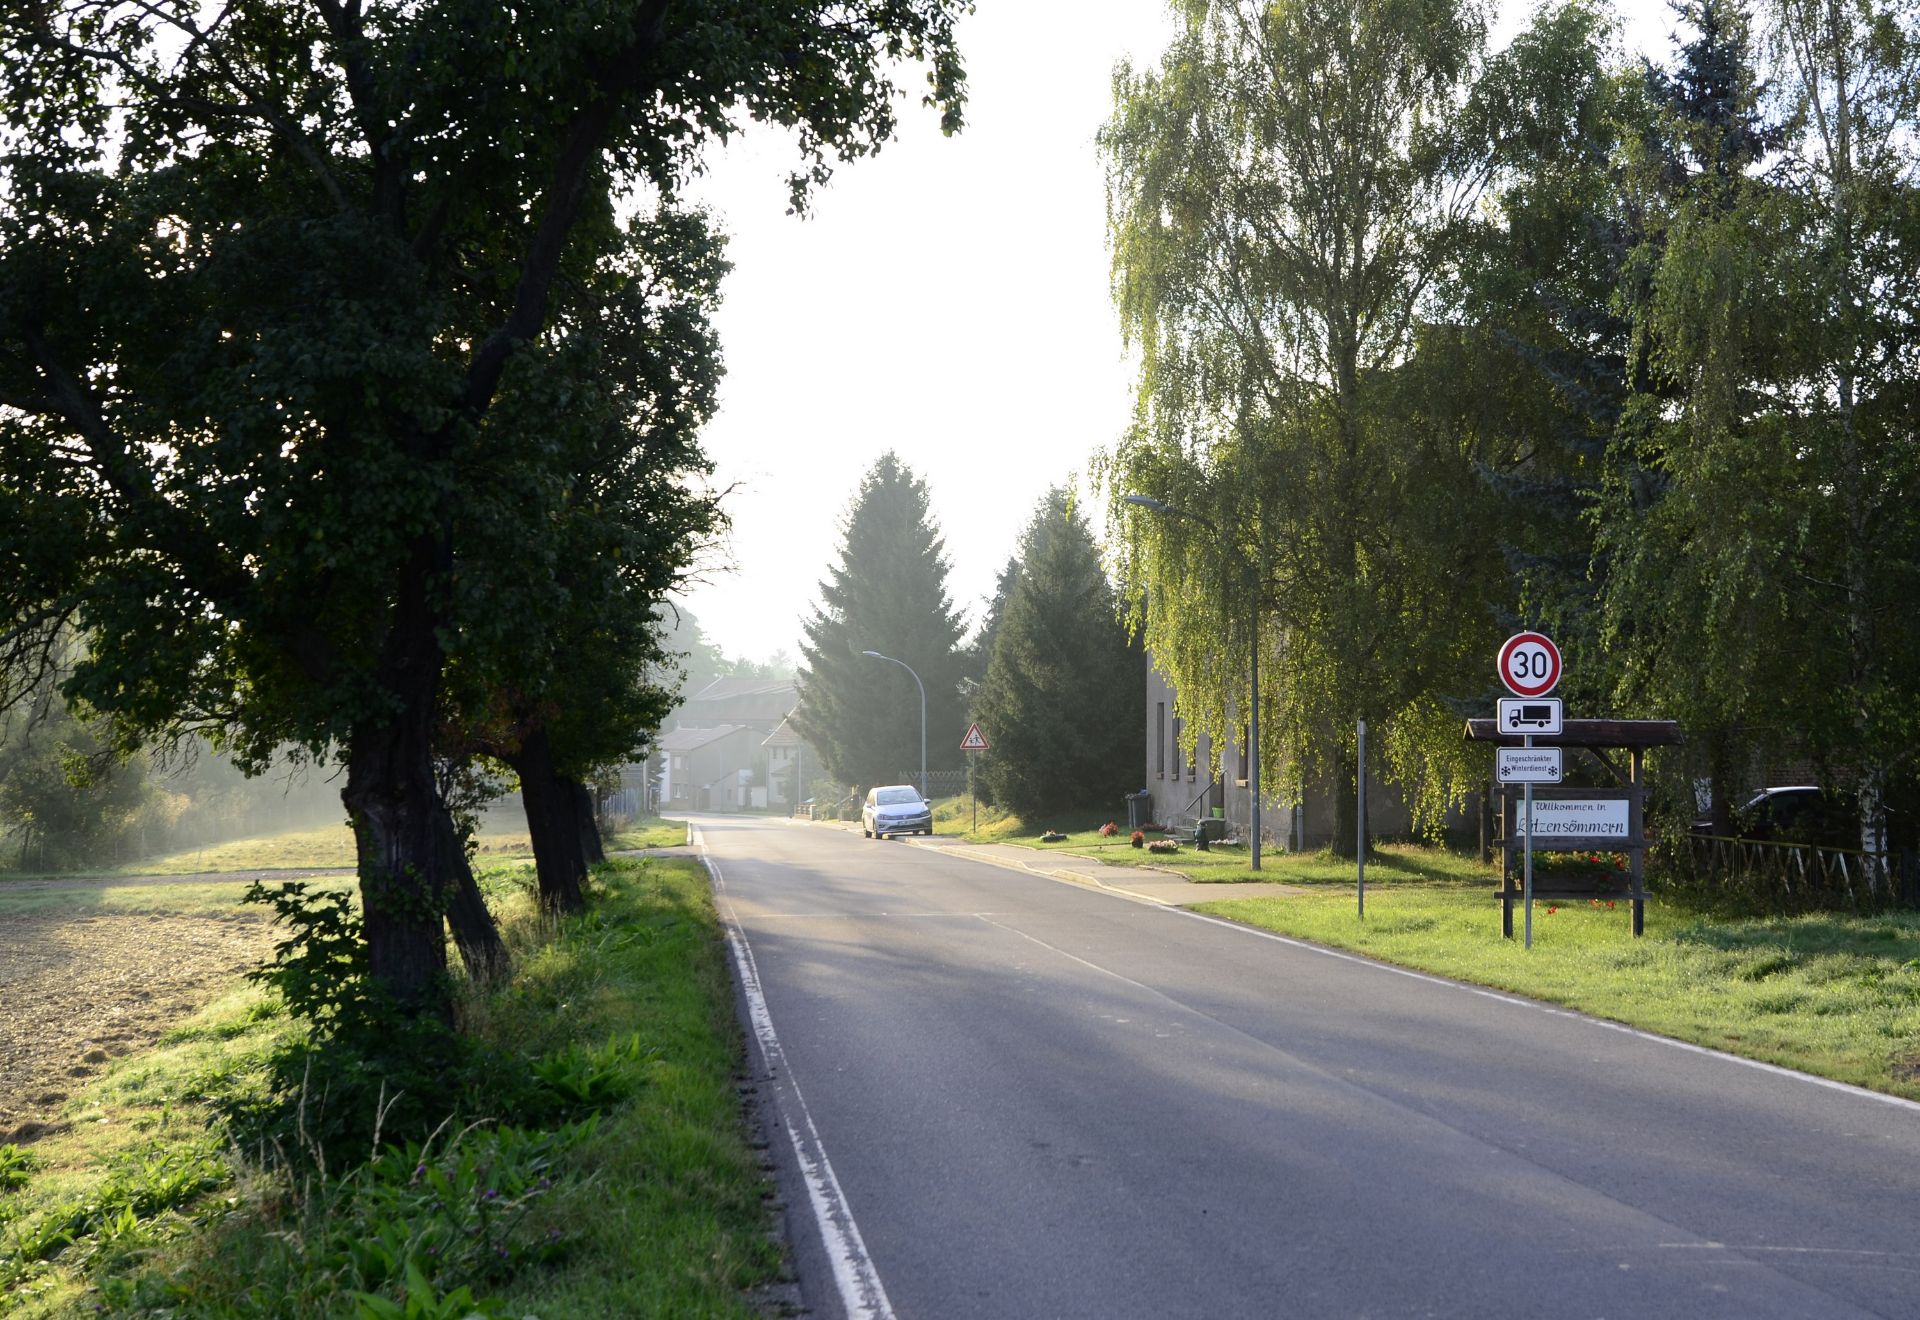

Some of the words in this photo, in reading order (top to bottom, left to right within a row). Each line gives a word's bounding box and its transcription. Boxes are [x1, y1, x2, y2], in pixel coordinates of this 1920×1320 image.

[1513, 651, 1547, 679] 30
[1506, 755, 1552, 764] Eingeschränkter
[1535, 802, 1593, 811] Willkommen
[1596, 803, 1606, 811] in
